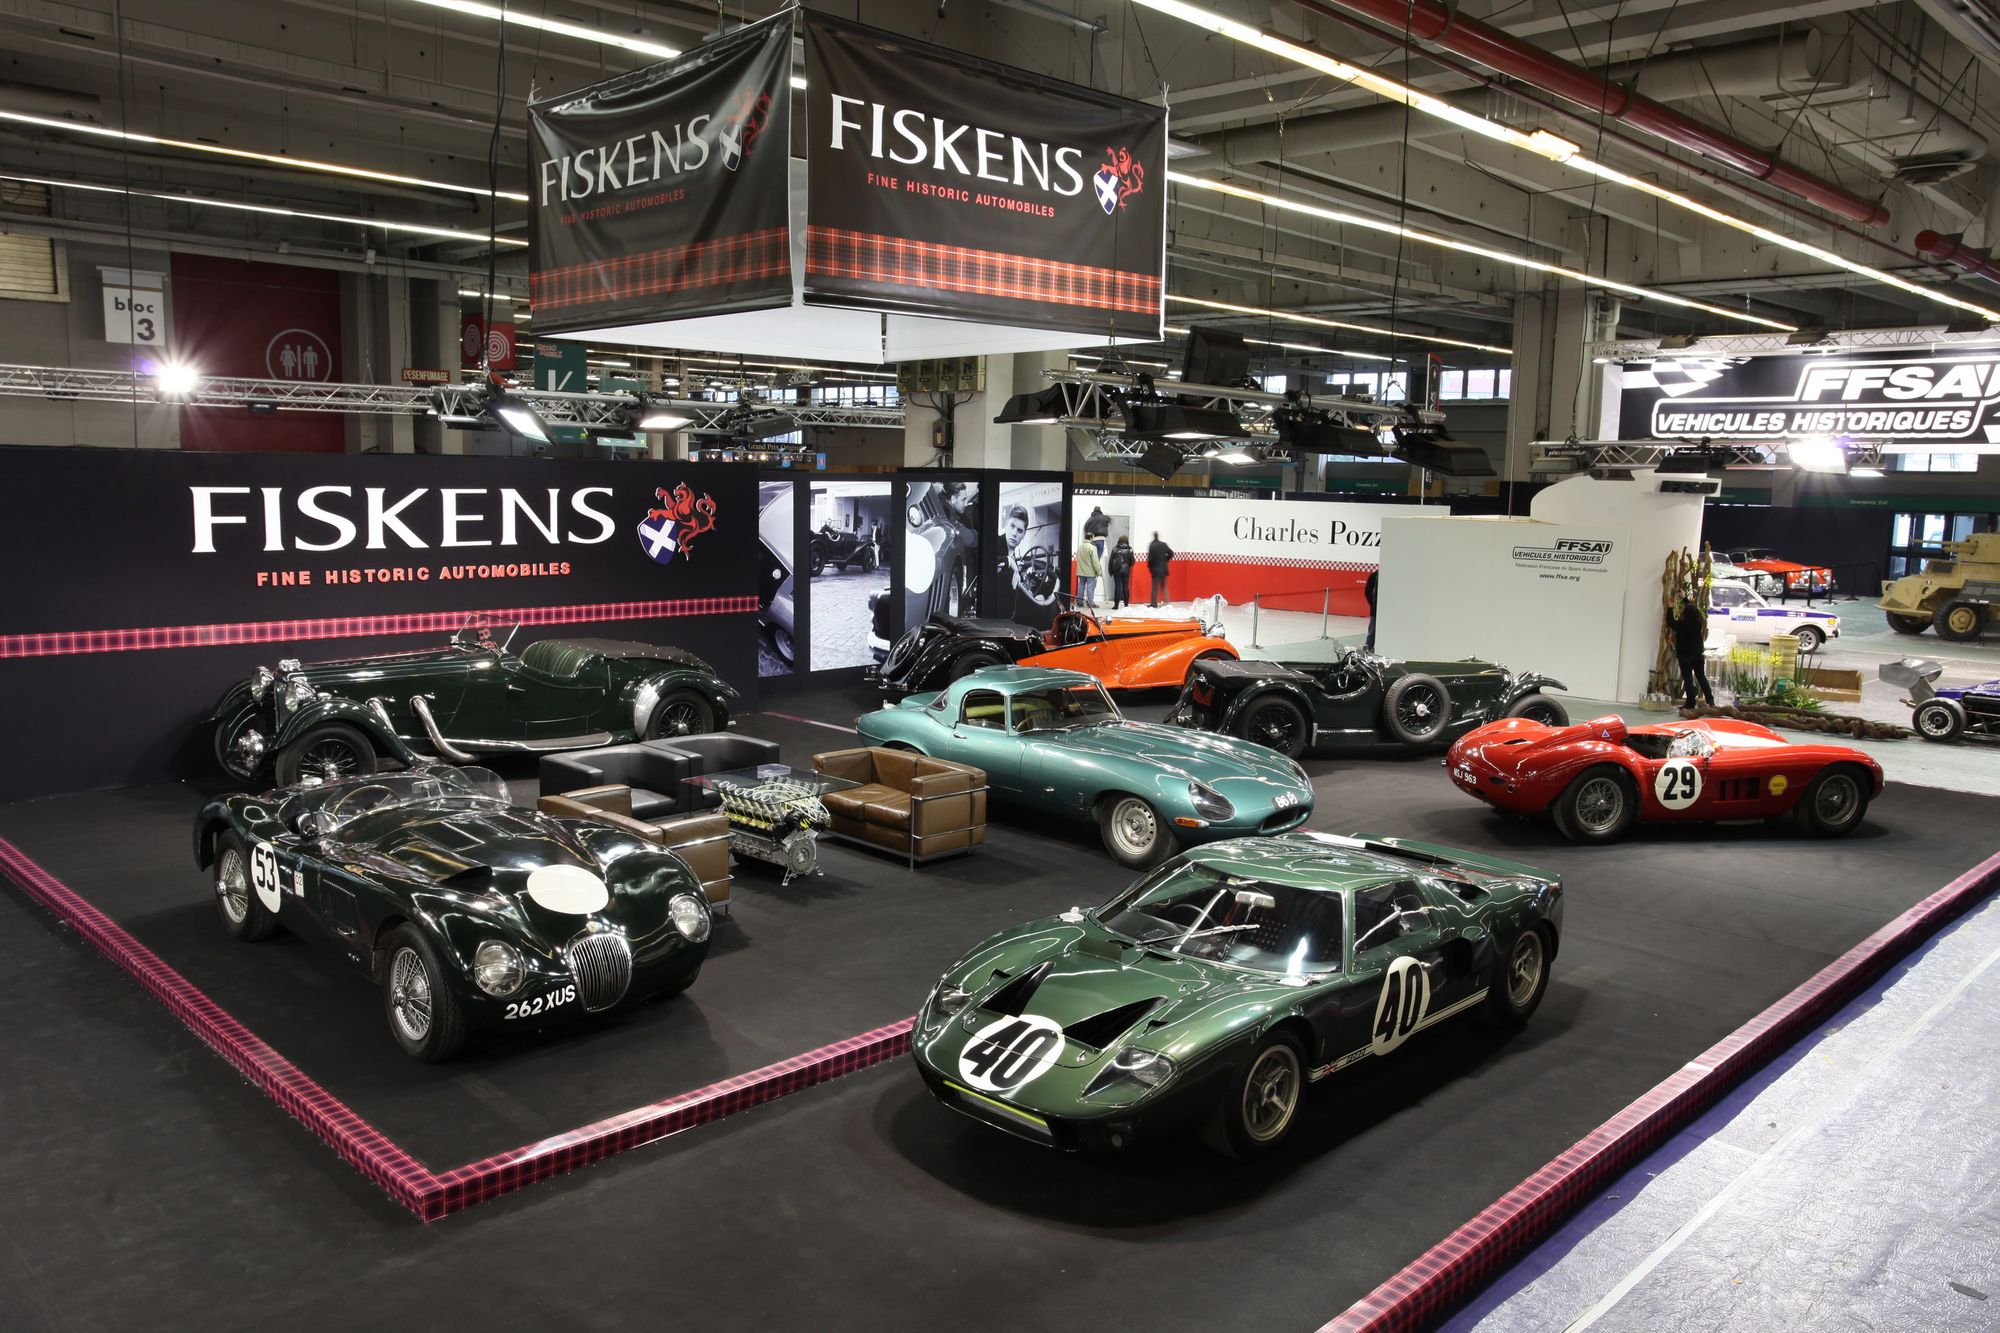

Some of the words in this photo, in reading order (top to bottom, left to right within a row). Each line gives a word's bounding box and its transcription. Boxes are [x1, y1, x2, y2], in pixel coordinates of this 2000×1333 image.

[541, 114, 711, 207] FISKENS
[830, 93, 1084, 196] FISKENS
[560, 213, 576, 226] FINE
[579, 205, 621, 221] HISTORIC
[624, 188, 686, 212] AUTOMOBILES
[867, 172, 899, 190] FINE
[907, 180, 969, 203] HISTORIC
[975, 193, 1055, 218] AUTOMOBILES
[114, 296, 155, 314] bloc
[137, 317, 156, 342] 3
[1658, 411, 1786, 432] VEHICULES
[1792, 410, 1974, 432] HISTORIQUES
[189, 485, 616, 553] FISKENS
[1233, 515, 1319, 544] Charles
[256, 571, 311, 587] FINE
[325, 567, 430, 585] HISTORIC
[439, 562, 571, 580] AUTOMOBILES
[1514, 551, 1552, 560] VEHICULES
[1553, 553, 1601, 563] HISTORIQUES
[1539, 573, 1581, 582] www.ffsa.org
[1464, 772, 1477, 785] 963
[1663, 766, 1696, 801] 29
[255, 846, 276, 893] 53
[504, 997, 543, 1020] 262
[545, 984, 576, 1011] XUS
[1374, 963, 1423, 1044] 40
[961, 1020, 1059, 1089] 40
